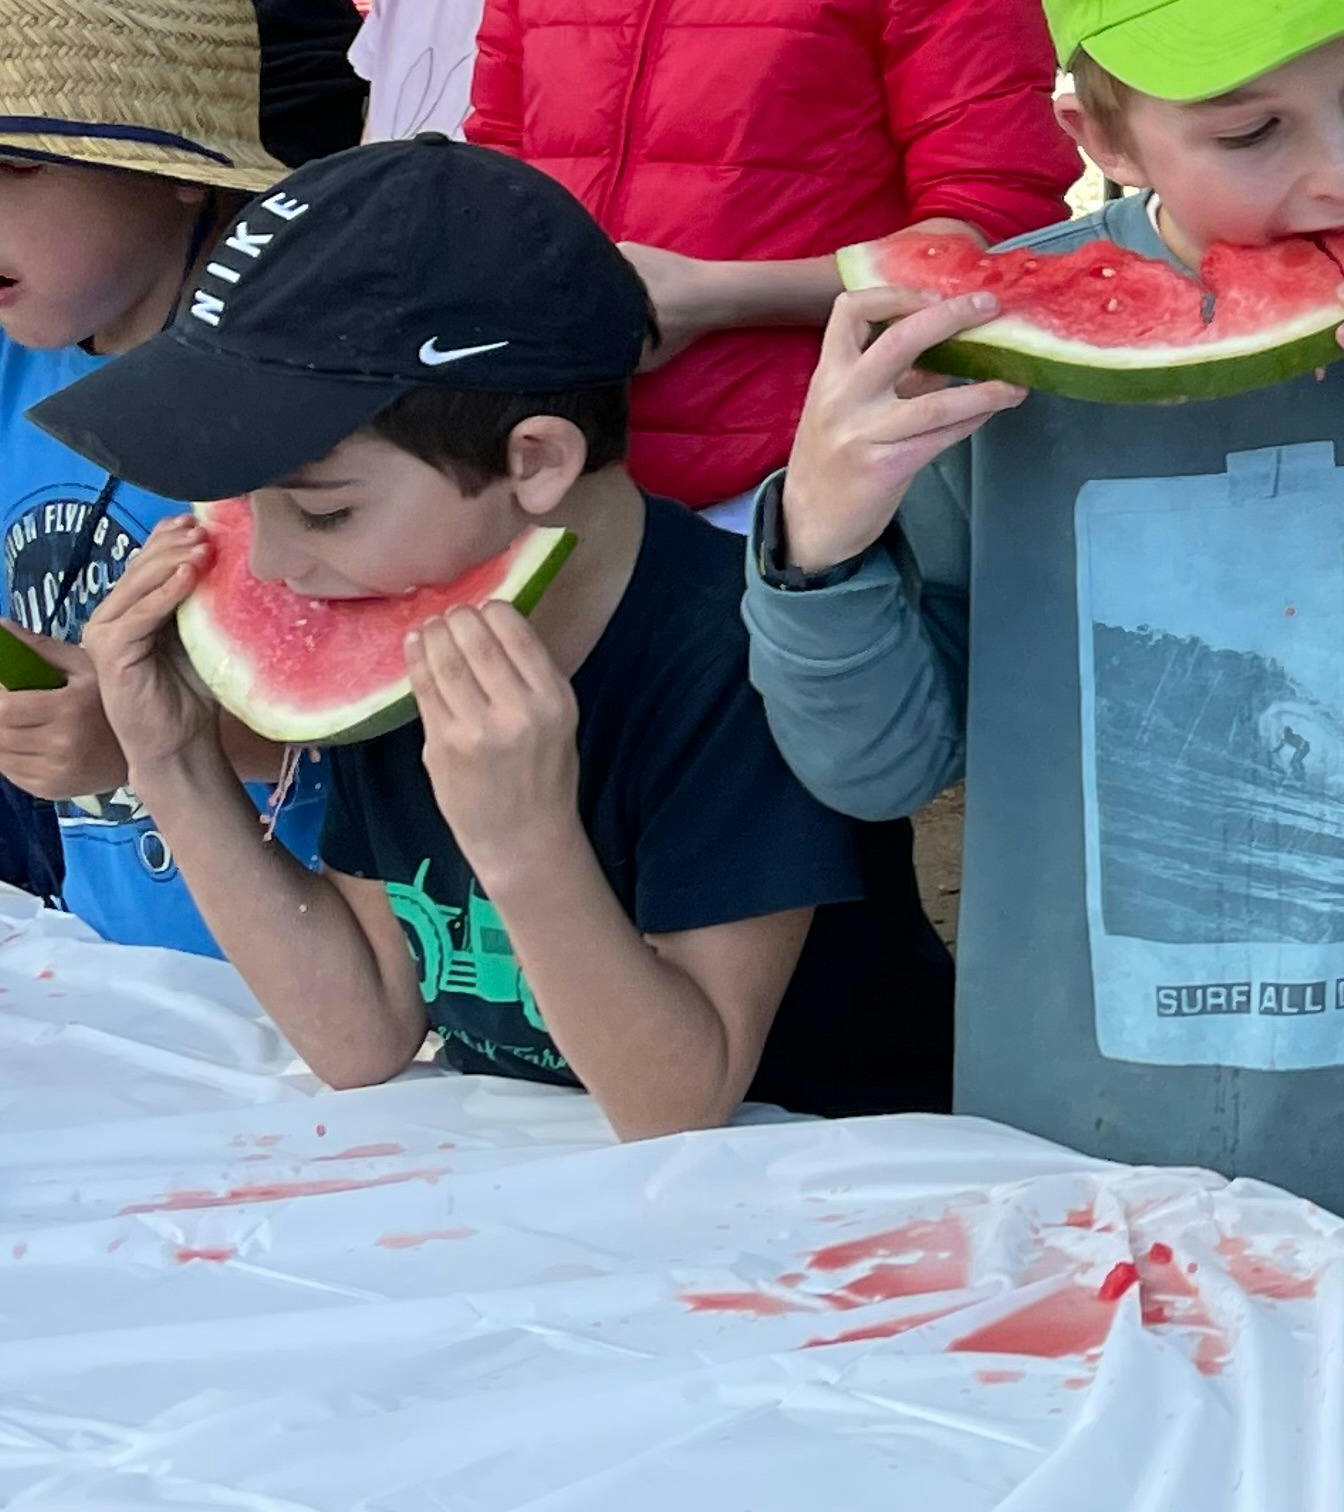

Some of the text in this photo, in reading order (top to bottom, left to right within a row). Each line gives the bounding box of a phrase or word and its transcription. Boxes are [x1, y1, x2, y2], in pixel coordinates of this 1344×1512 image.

[190, 191, 310, 327] NIKE
[44, 502, 109, 546] FLYIG
[1156, 984, 1250, 1016] SURF
[1259, 985, 1323, 1014] ALL
